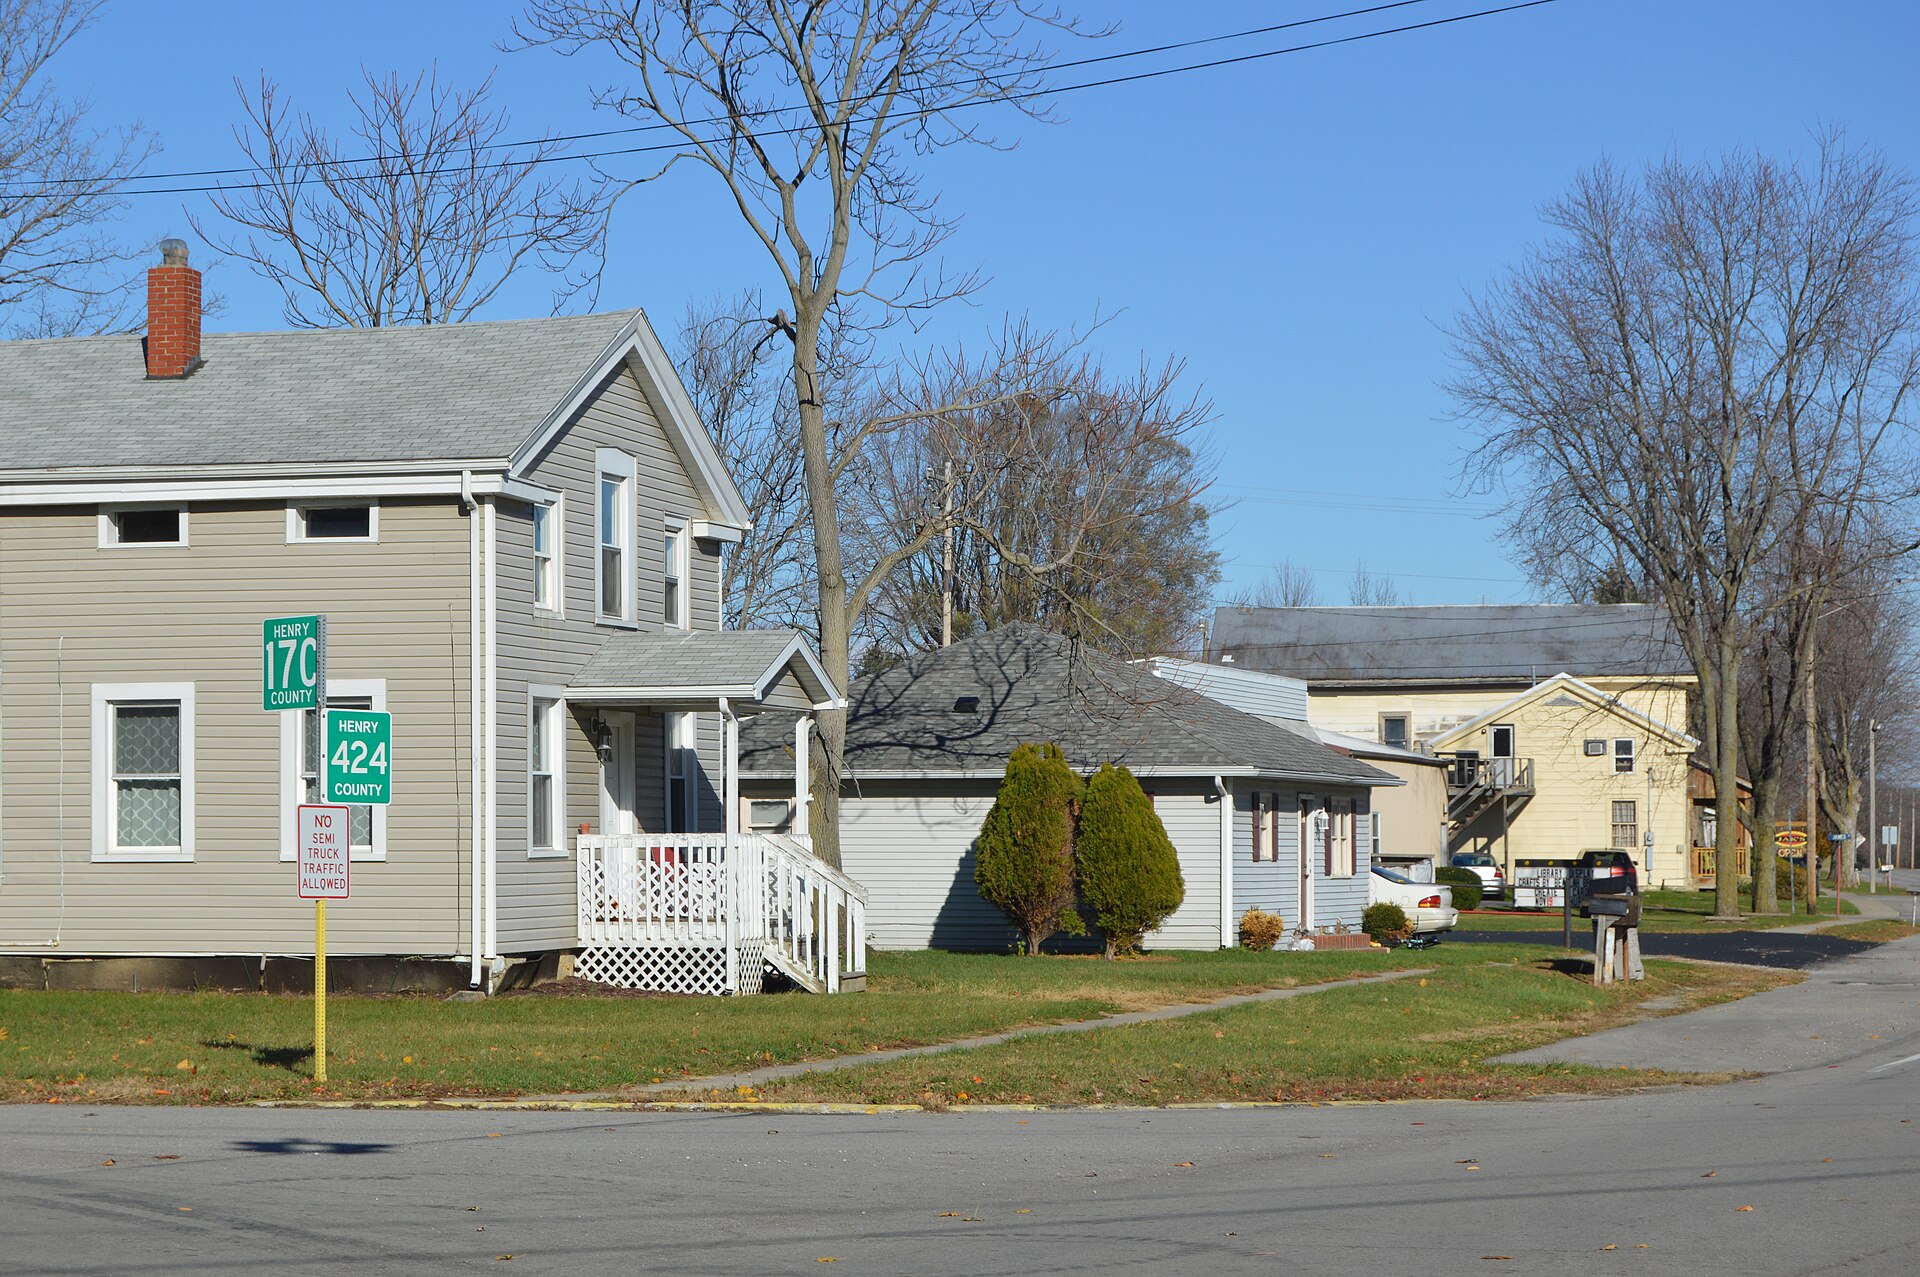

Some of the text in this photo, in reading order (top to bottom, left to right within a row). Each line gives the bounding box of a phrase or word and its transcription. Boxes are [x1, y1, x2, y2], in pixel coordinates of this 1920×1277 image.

[273, 622, 310, 638] HENRY
[270, 689, 313, 705] COUNTY
[338, 719, 379, 734] HENRY
[330, 740, 388, 775] 424
[334, 782, 383, 797] COUNTY
[314, 815, 332, 828] NO
[312, 832, 335, 844] SEMI
[307, 847, 339, 860] TRUCK
[1778, 848, 1803, 858] OPEN
[303, 862, 344, 875] TRAFFIC
[1536, 868, 1563, 878] LIBRARY
[302, 877, 346, 890] ALLOWED
[1518, 878, 1540, 887] CRAFTS
[1542, 878, 1550, 887] BY
[1535, 888, 1558, 897] CREATE
